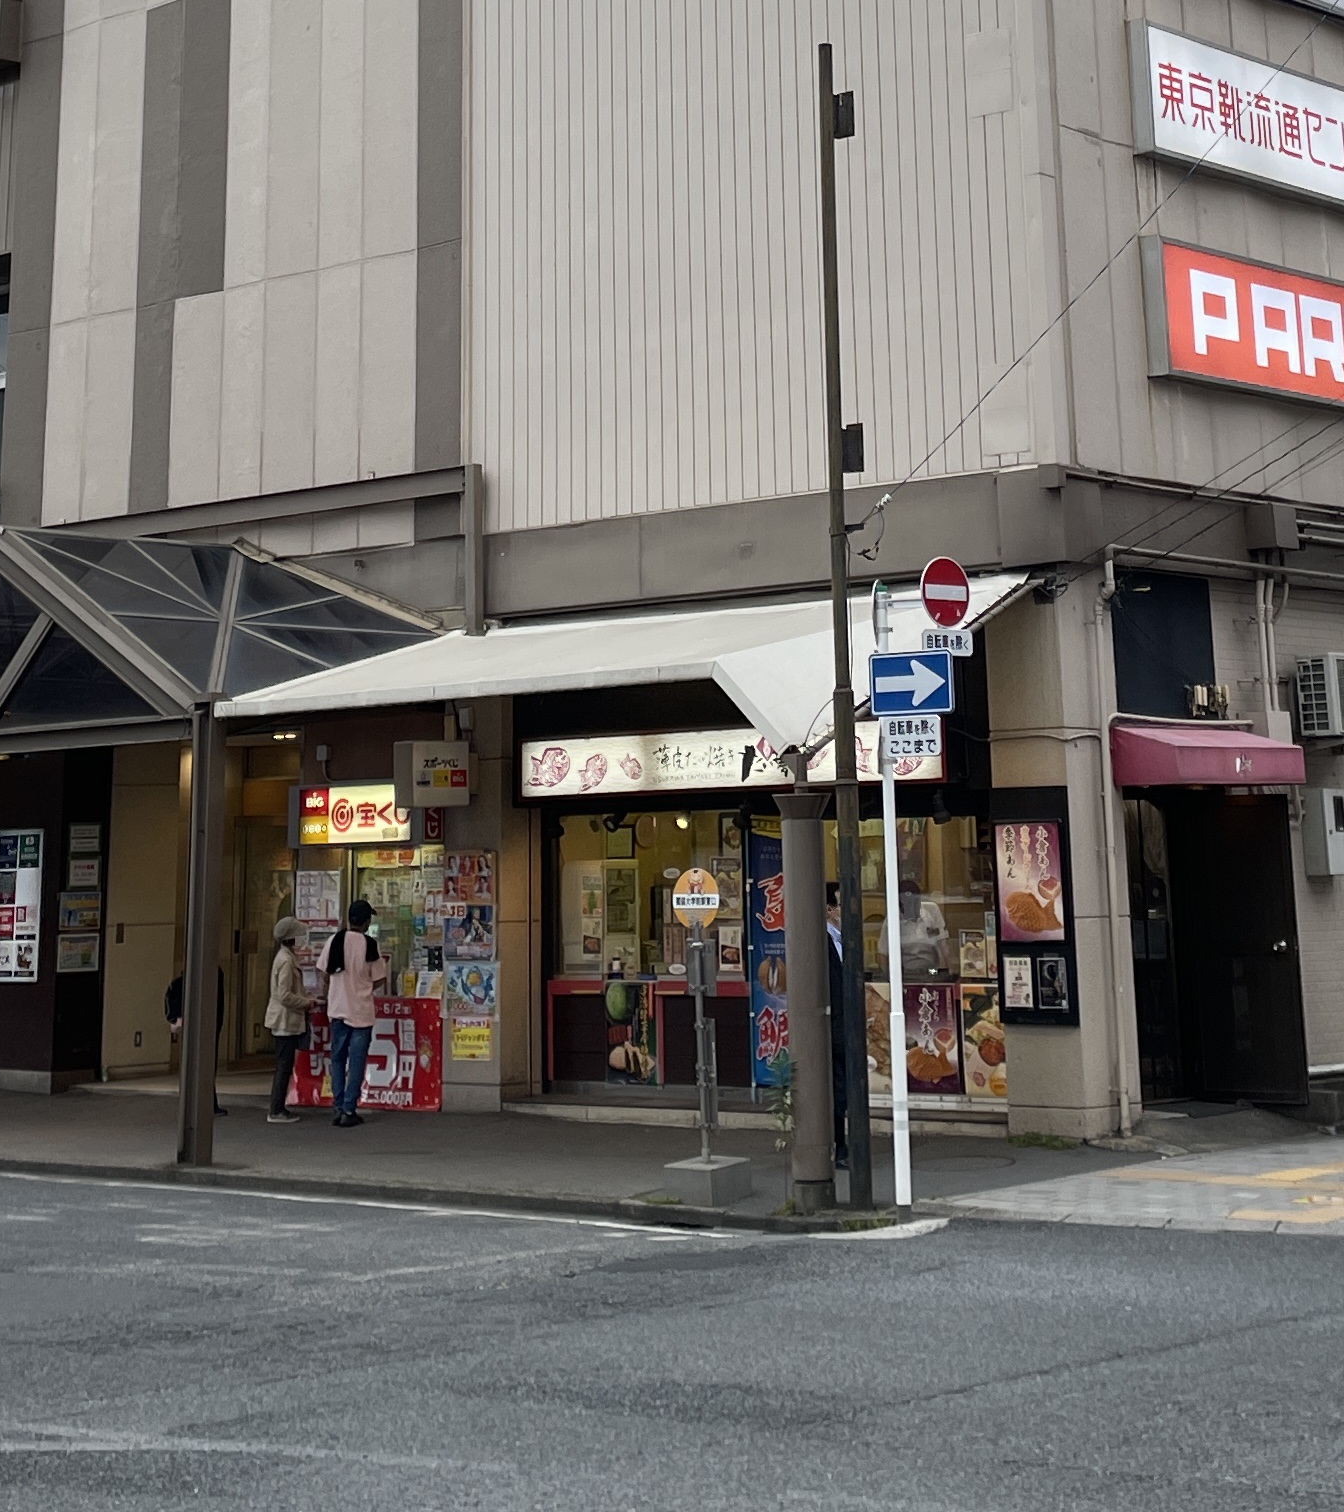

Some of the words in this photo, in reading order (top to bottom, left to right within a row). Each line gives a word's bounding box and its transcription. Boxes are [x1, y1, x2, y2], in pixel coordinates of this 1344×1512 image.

[926, 634, 969, 650] 自転車を除く
[889, 719, 935, 736] 自転車を除く
[890, 739, 937, 754] ここまで
[423, 756, 460, 769] スポーツくじ
